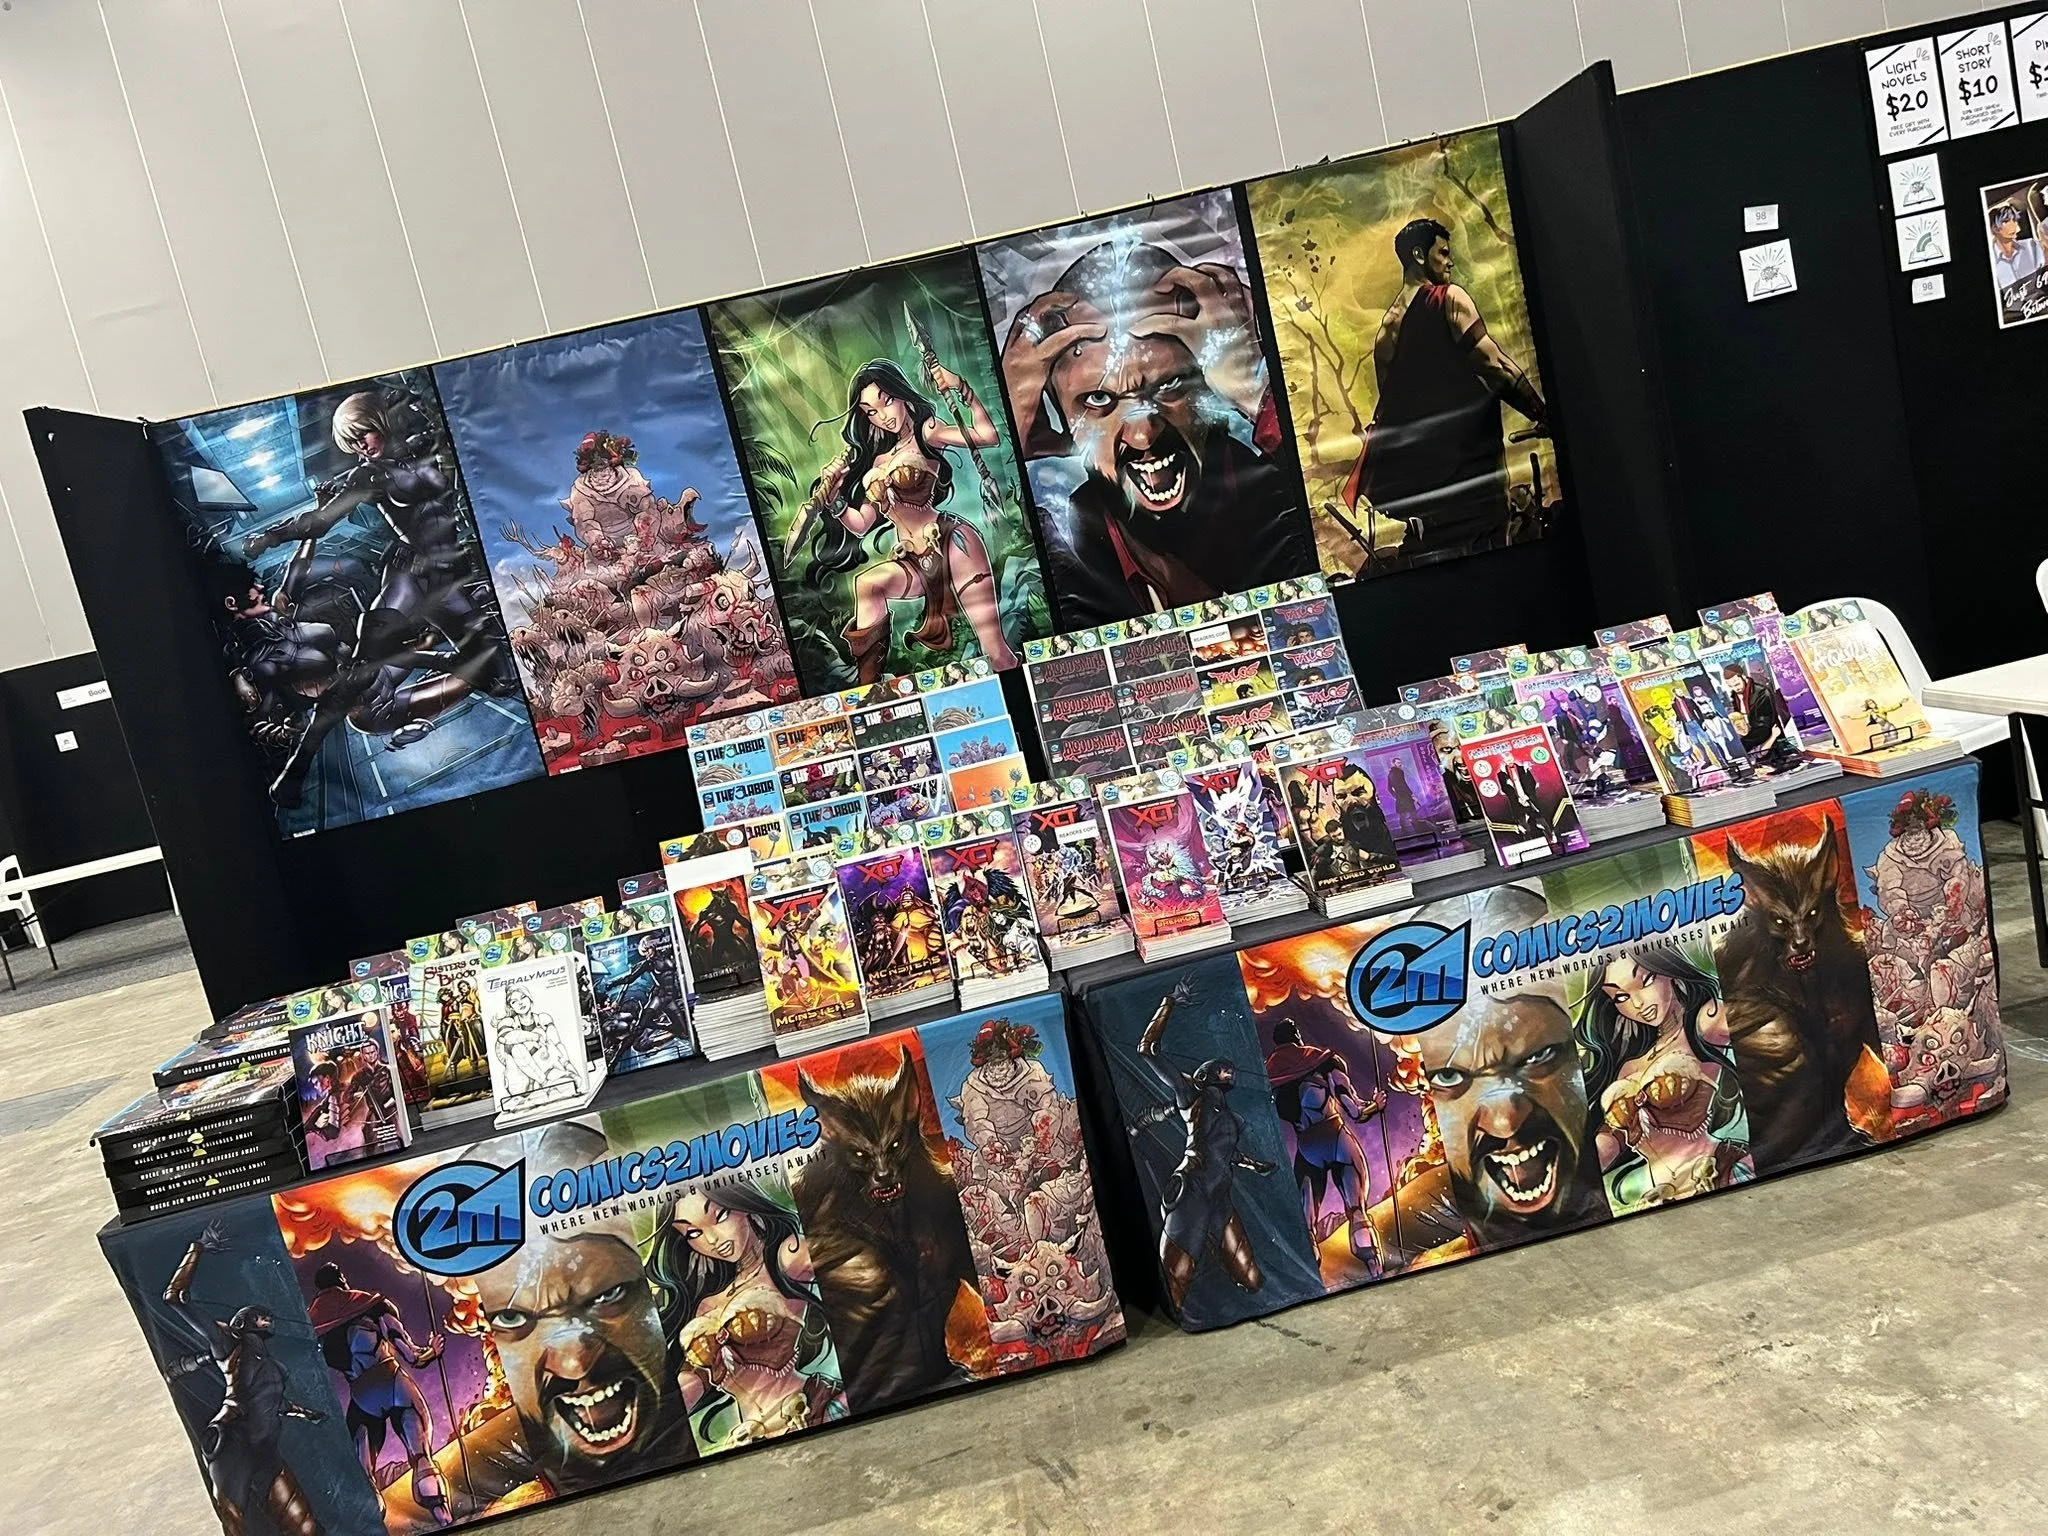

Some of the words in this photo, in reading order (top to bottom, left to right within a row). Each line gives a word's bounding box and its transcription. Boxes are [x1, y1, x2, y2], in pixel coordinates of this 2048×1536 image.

[1956, 43, 1991, 60] SHORT
[1959, 57, 1992, 73] STORY
[1882, 72, 1927, 89] NOVELS
[1886, 60, 1917, 74] LIGHT
[1958, 75, 1998, 105] $10
[1886, 90, 1928, 121] $20
[1208, 661, 1260, 684] TALOS
[1135, 672, 1194, 702] BLOODSMITH
[1053, 690, 1115, 722] BLOODSMITH
[1219, 702, 1273, 728] TALOS
[1143, 715, 1208, 745] BLOODSMITH
[707, 746, 725, 762] THE
[735, 738, 765, 754] LABOR
[1062, 729, 1126, 763] BLOODSMITH
[715, 791, 734, 804] THE
[744, 780, 774, 796] LABOR
[831, 800, 861, 817] LABOR
[1032, 807, 1080, 832] XCT
[1128, 799, 1176, 830] XCT
[857, 854, 904, 884] XCT
[945, 838, 1000, 873] XCT
[1318, 869, 1364, 887] FRACTURED
[1368, 862, 1396, 877] WORLD
[1472, 872, 1745, 979] COMICS2MOVIES
[424, 961, 467, 980] SISTERS
[1480, 974, 1523, 996] WHERE
[1529, 966, 1556, 983] NEW
[1562, 953, 1614, 975] WORLDS
[1620, 950, 1627, 959] &
[1634, 928, 1704, 957] UNIVERSES
[1711, 917, 1750, 937] AWAIT
[438, 970, 476, 986] BLOOD
[487, 965, 566, 990] TERRALYMPUS
[776, 999, 856, 1027] MONSTERS
[305, 1021, 368, 1052] KNIGHT
[529, 1104, 821, 1218] COMICS2MOVIES
[539, 1212, 586, 1235] WHERE
[593, 1203, 620, 1221] NEW
[628, 1188, 683, 1211] WORLDS
[689, 1185, 697, 1196] &
[703, 1162, 779, 1192] UNIVERSES
[786, 1149, 828, 1171] AWAIT
